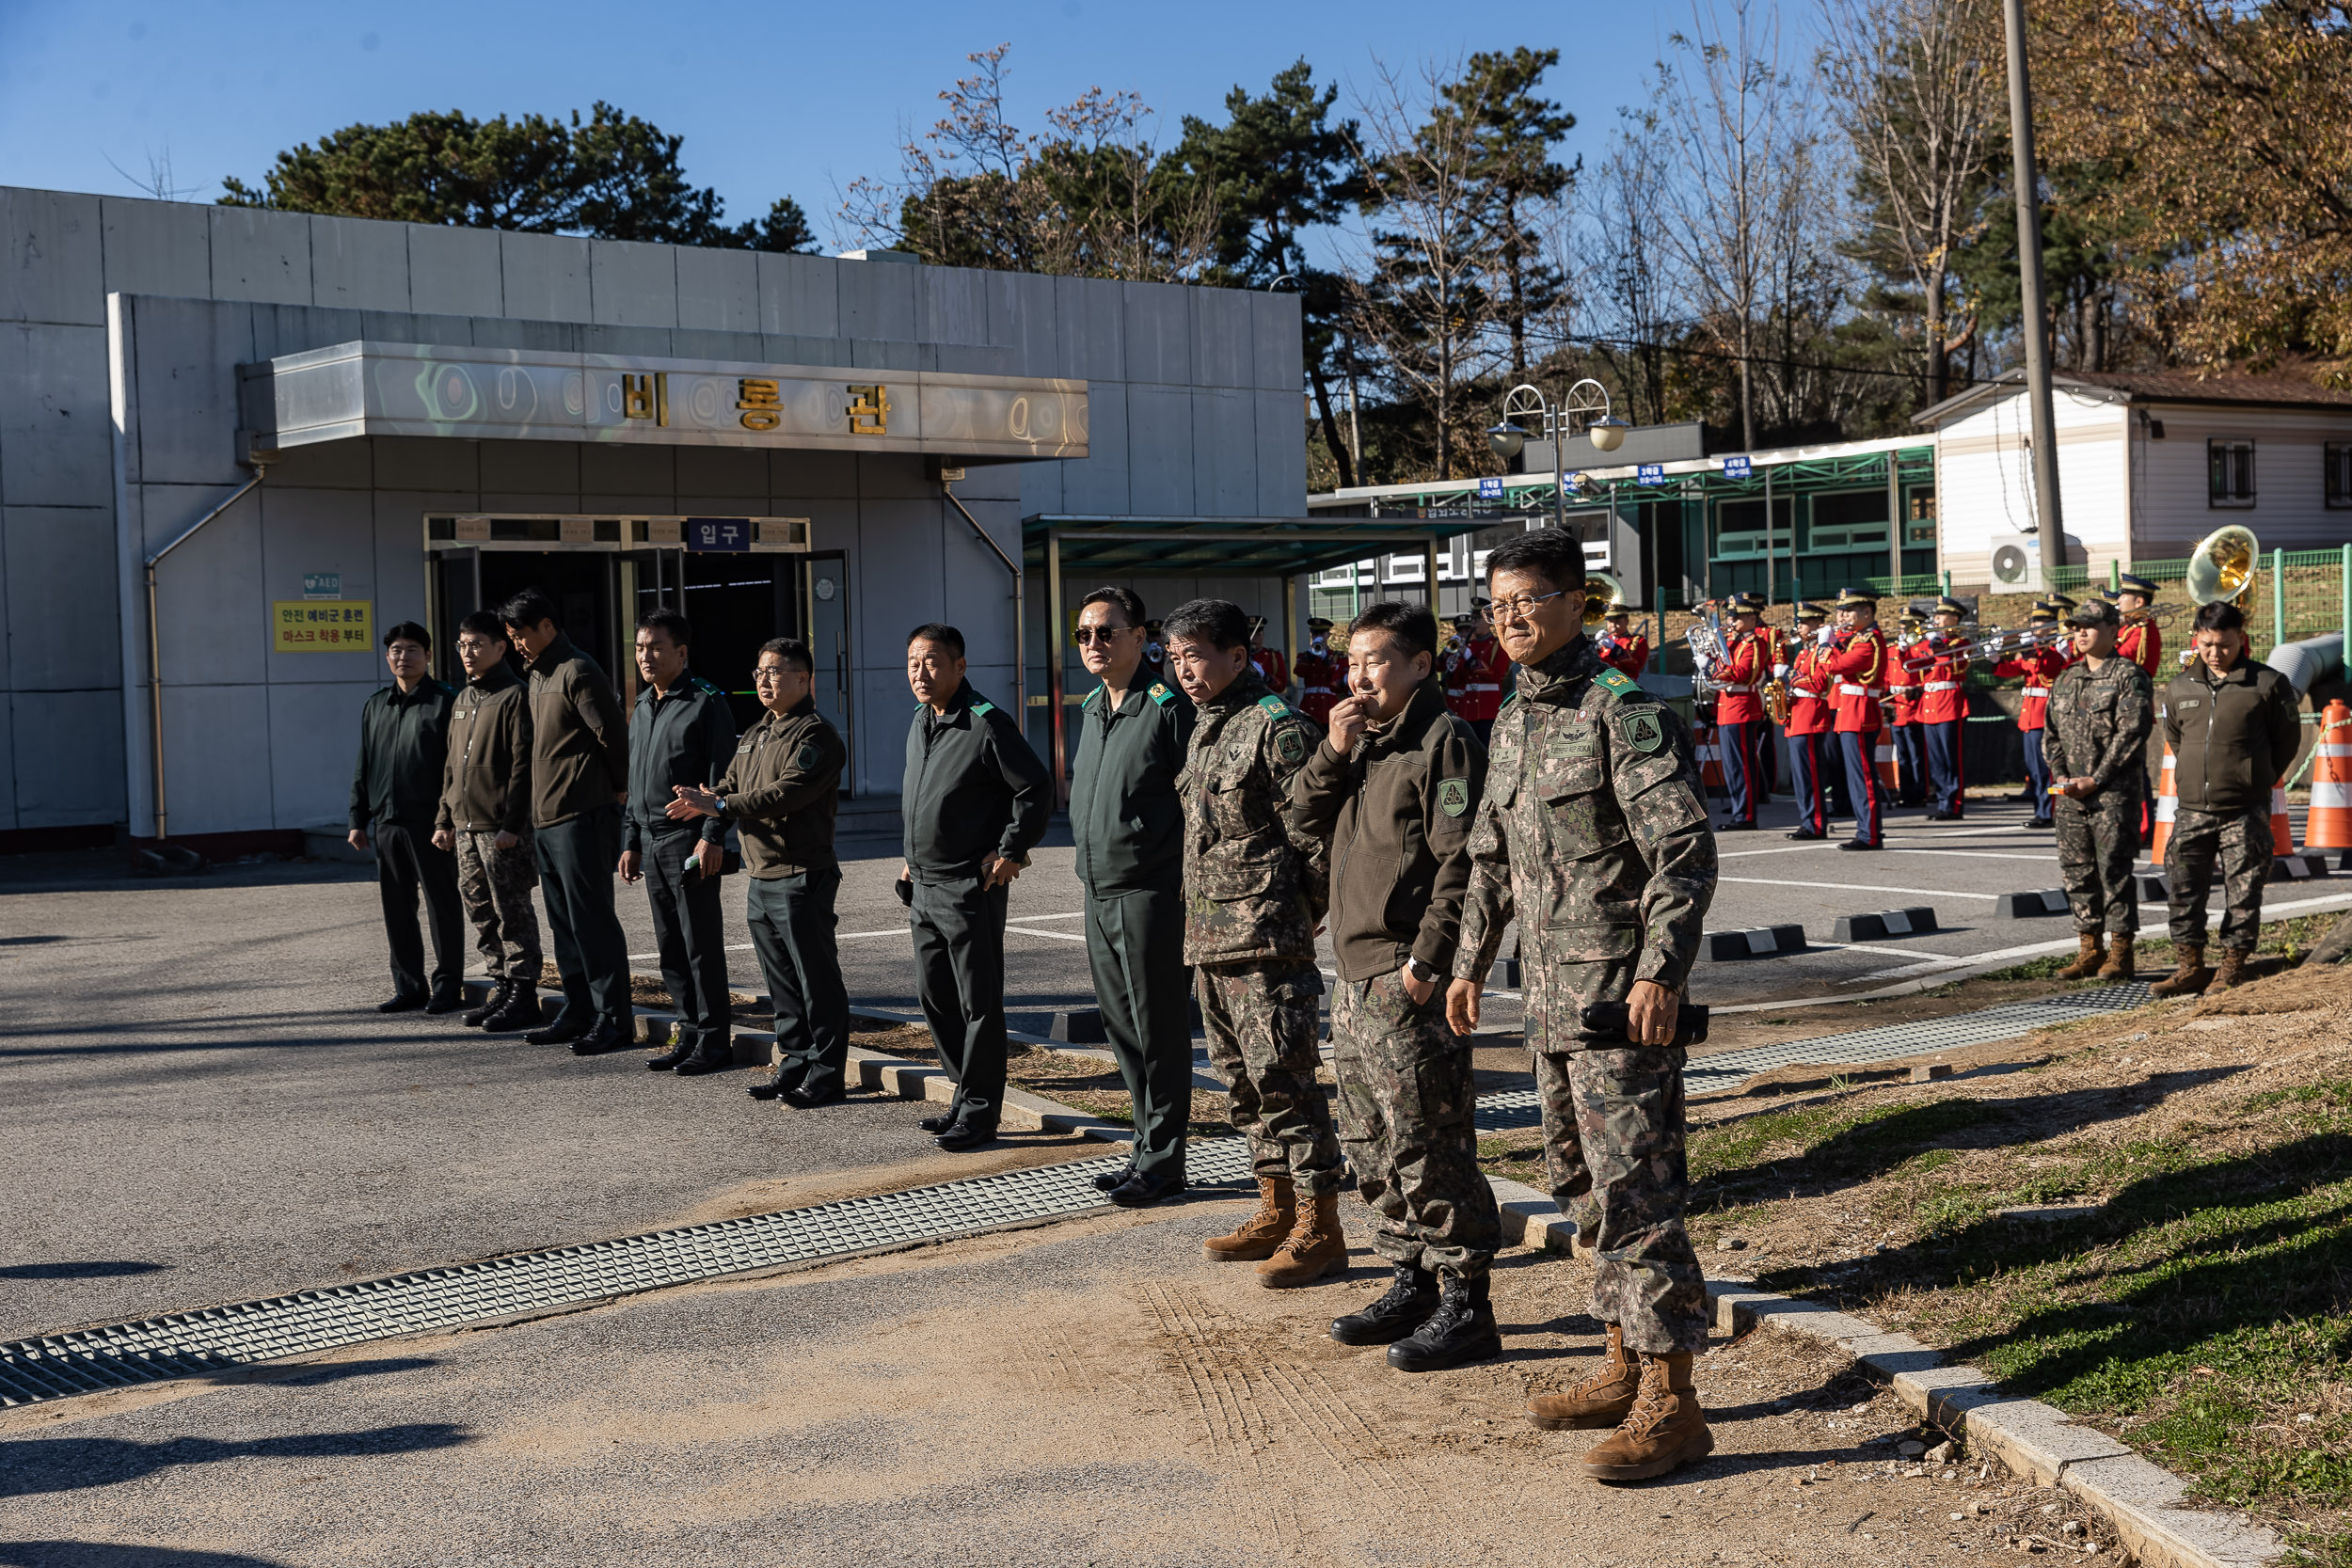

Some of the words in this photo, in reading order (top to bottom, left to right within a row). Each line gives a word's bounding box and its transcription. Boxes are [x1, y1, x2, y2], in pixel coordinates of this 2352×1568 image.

[700, 525, 739, 546] 입구
[318, 577, 339, 588] AED
[281, 609, 305, 623] 안전
[307, 609, 340, 623] 예비군
[342, 608, 364, 623] 훈련
[282, 629, 316, 643] 마스크
[319, 628, 340, 643] 착용
[342, 628, 365, 642] 부터
